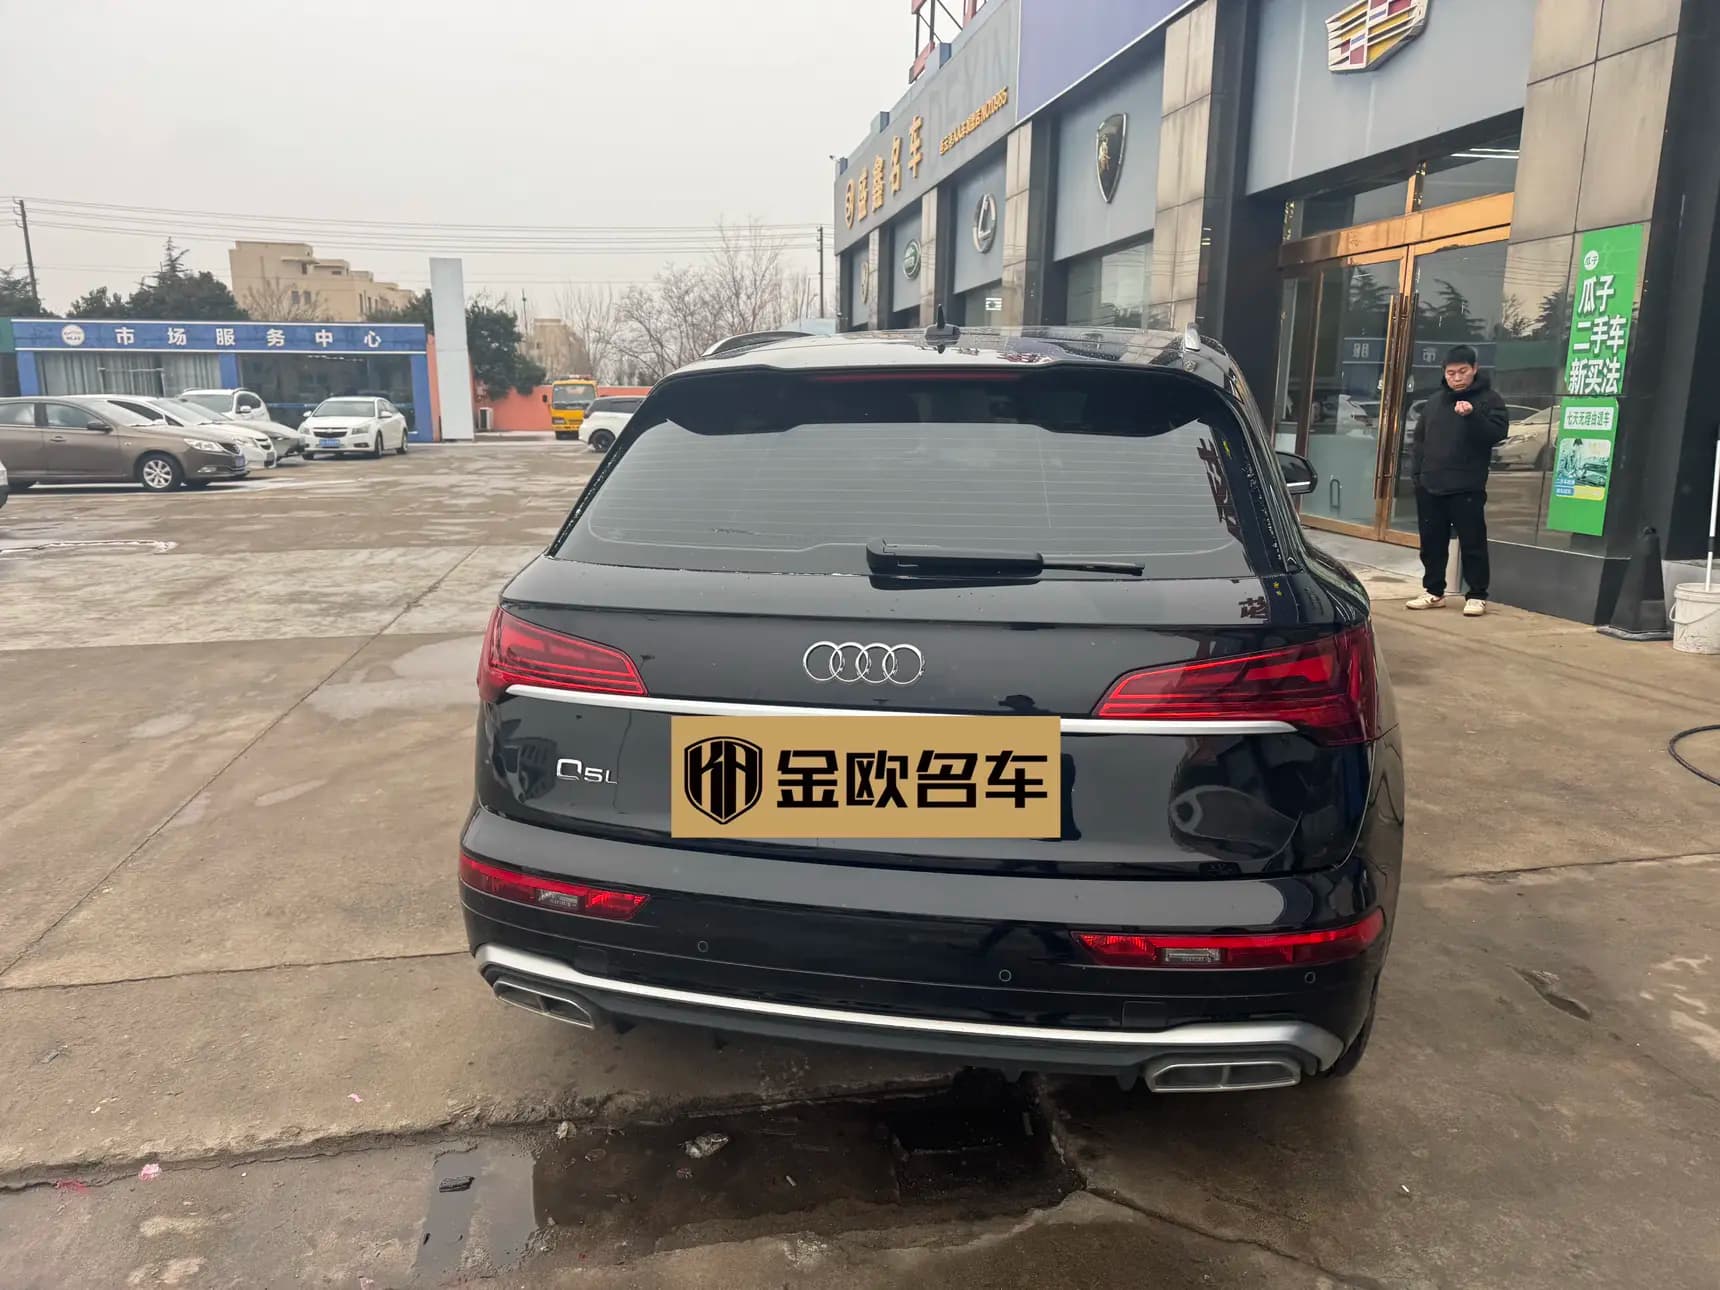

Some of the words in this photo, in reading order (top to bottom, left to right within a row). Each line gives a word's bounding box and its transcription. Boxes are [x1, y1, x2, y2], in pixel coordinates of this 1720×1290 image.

[1578, 275, 1614, 313] 瓜子
[116, 327, 382, 348] 市场服务中心
[1573, 315, 1626, 354] 二手车
[1568, 357, 1620, 394] 新买法
[557, 758, 618, 784] Q5L
